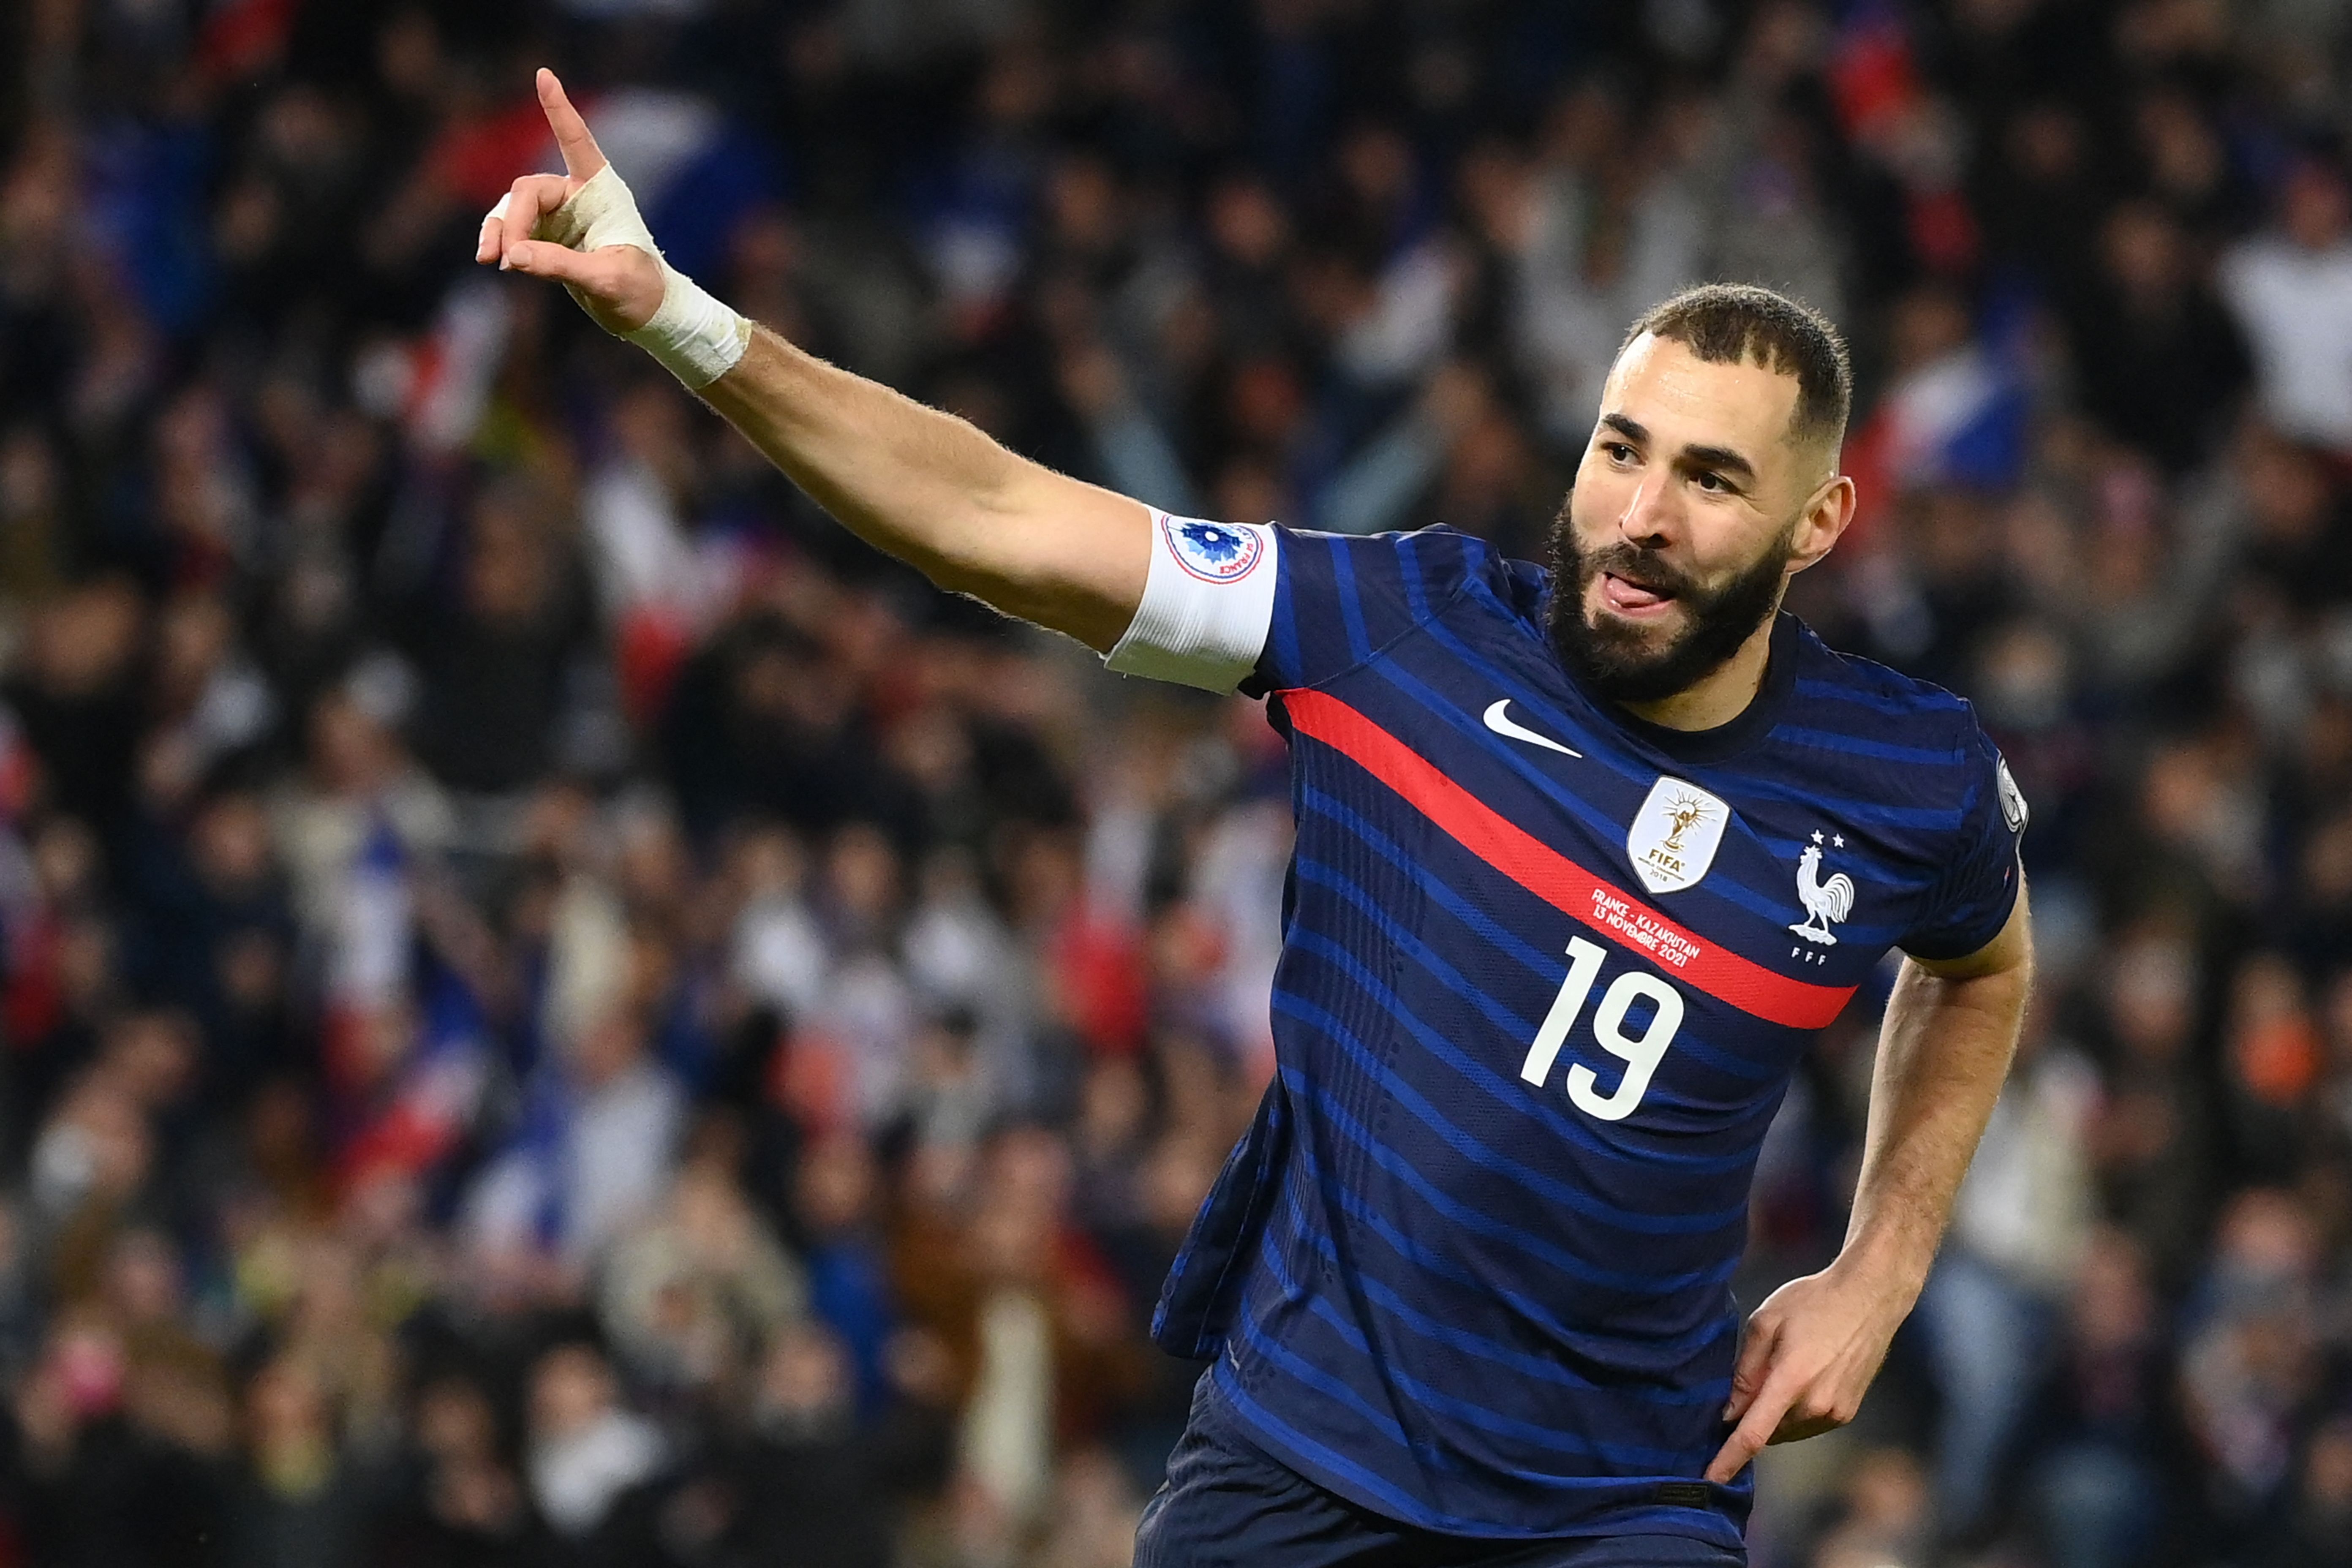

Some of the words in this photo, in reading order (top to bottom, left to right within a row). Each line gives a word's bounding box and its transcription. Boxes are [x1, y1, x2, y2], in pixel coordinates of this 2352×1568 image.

[1219, 553, 1250, 574] FRANCE
[1649, 849, 1680, 872] FIFA
[1650, 868, 1668, 882] 2018
[1591, 888, 1630, 917] FRANCE
[1636, 914, 1701, 959] KAZAKHSTAN
[1593, 904, 1606, 919] 13
[1606, 913, 1660, 951] NOVEMBRE
[1658, 945, 1689, 968] 2021
[1520, 935, 1685, 1121] 19
